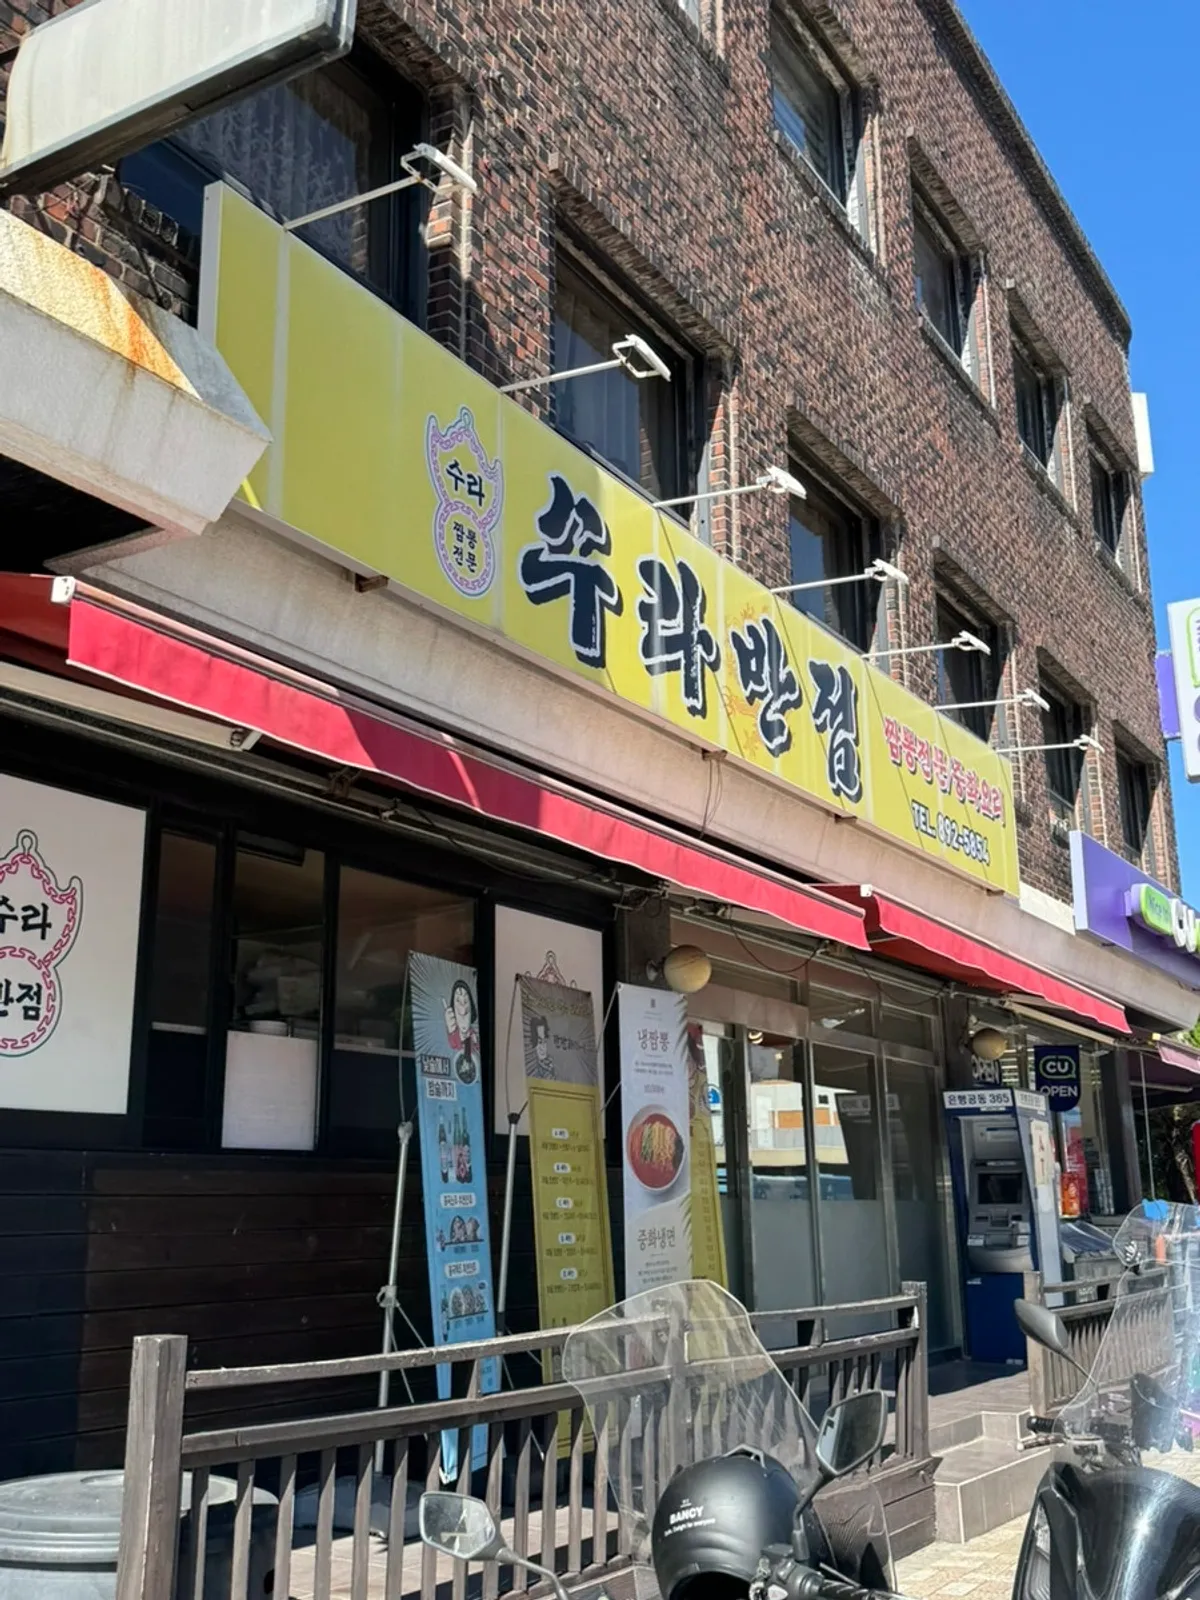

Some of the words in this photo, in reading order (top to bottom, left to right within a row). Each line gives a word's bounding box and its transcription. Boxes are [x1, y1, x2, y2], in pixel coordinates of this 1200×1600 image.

[446, 459, 485, 507] 수라
[452, 521, 478, 550] 짬뽕
[452, 544, 477, 574] 전문
[517, 472, 864, 804] 수라반점
[936, 811, 990, 867] 892-5854
[637, 1028, 670, 1052] 냉짬뽕
[1045, 1060, 1069, 1073] CU
[1039, 1085, 1078, 1097] OPEN
[637, 1226, 676, 1251] 중화냉면
